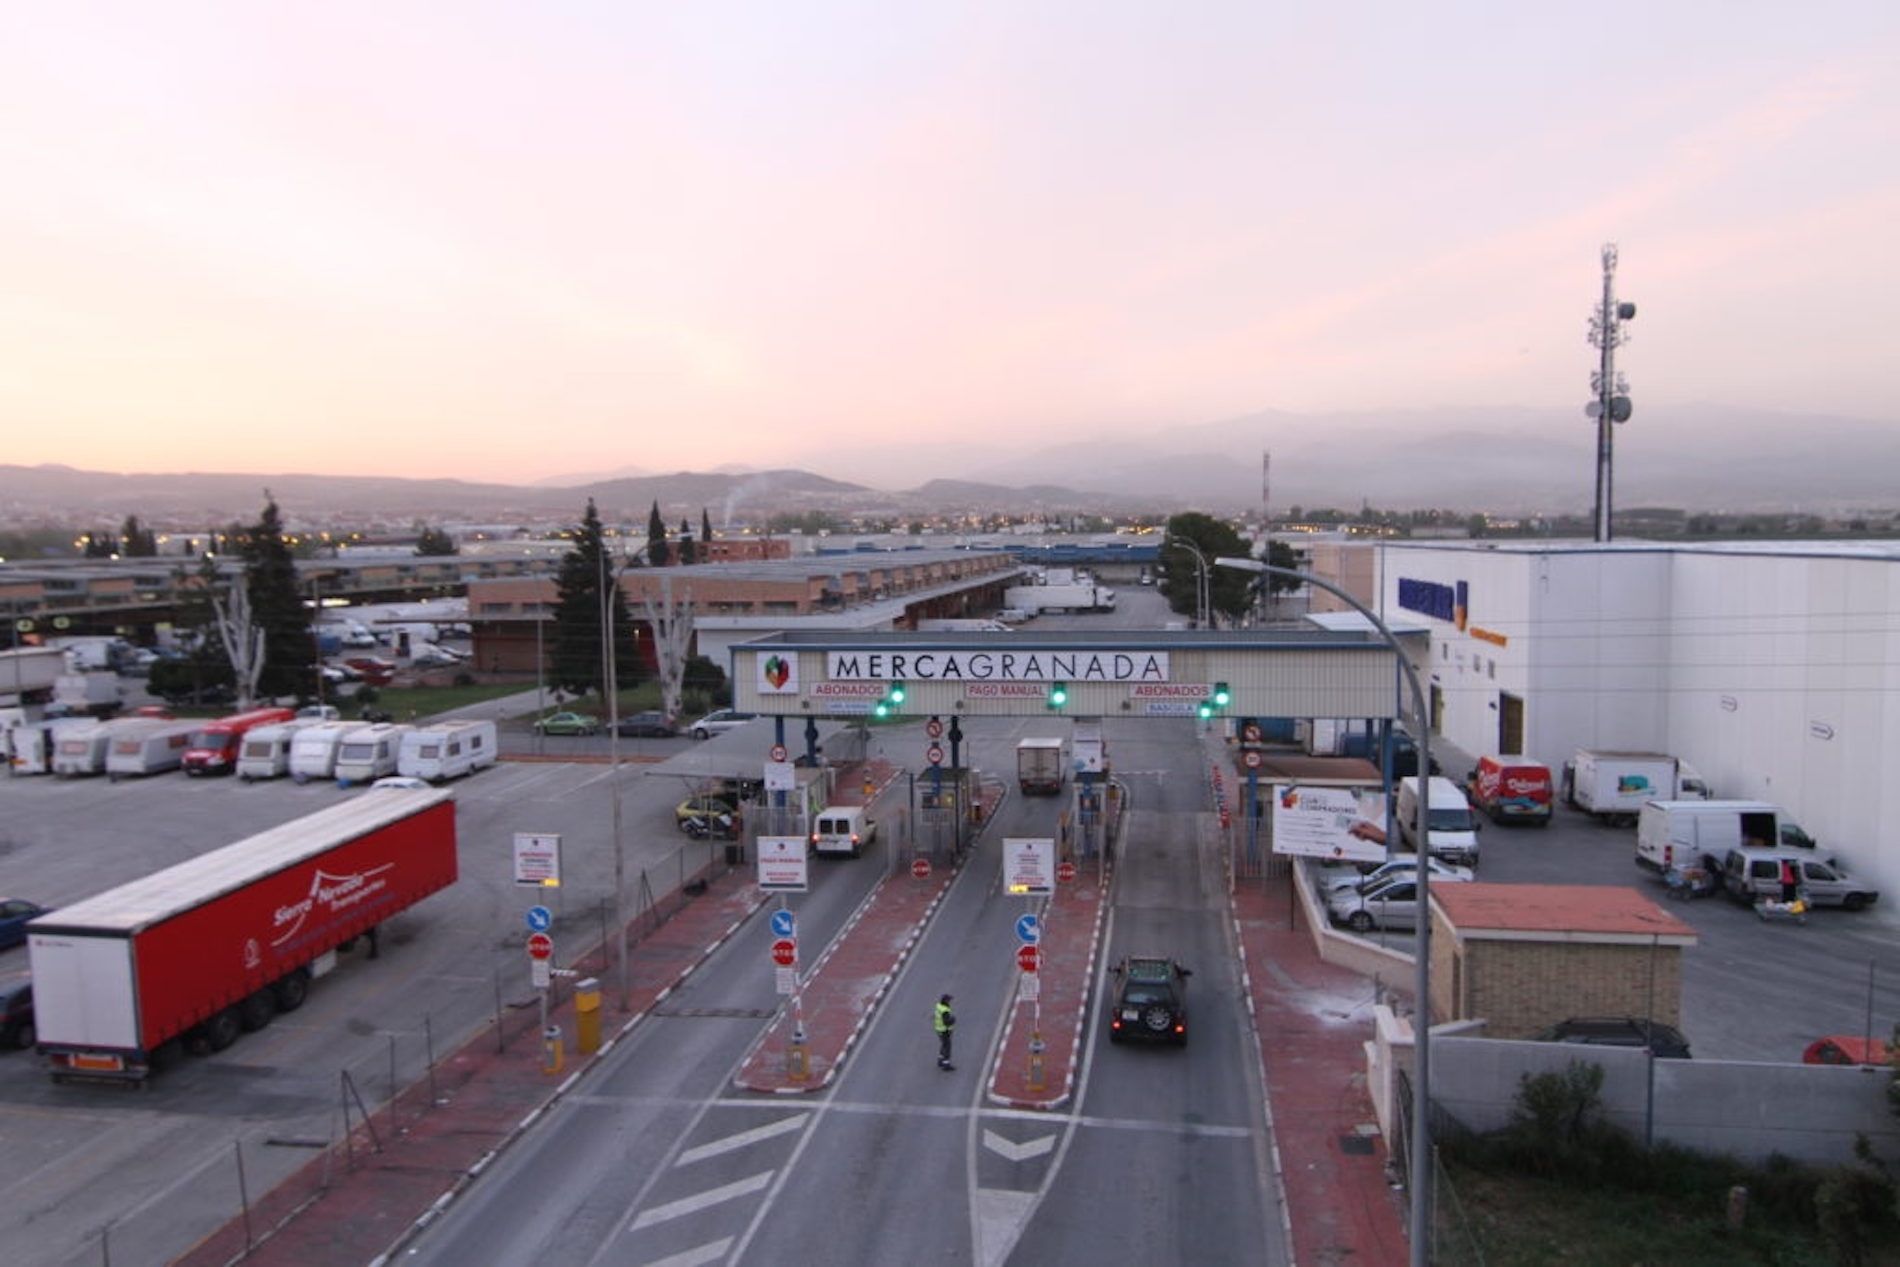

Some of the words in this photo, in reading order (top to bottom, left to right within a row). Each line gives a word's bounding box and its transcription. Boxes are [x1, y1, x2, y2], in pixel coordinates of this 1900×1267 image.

[836, 654, 1162, 679] MERCAGRANADA
[816, 684, 884, 694] ABONADOS
[969, 685, 998, 696] PAGO
[1001, 685, 1045, 697] MANUAL
[1135, 686, 1209, 696] ABONADOS
